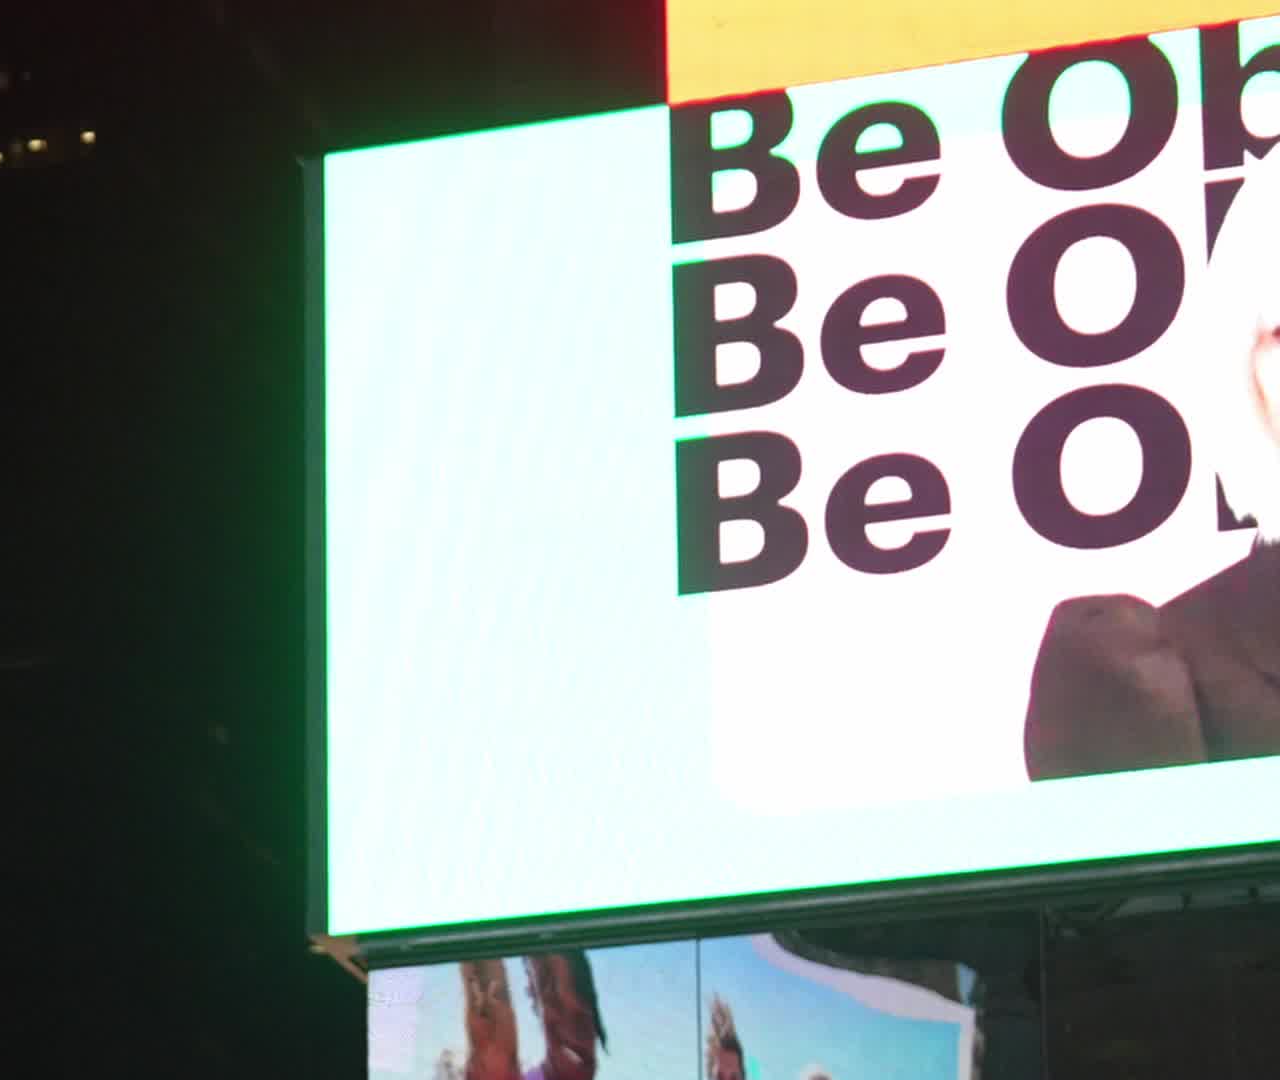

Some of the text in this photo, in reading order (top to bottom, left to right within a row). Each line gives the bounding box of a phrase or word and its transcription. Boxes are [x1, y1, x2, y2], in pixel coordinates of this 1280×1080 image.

[669, 88, 941, 246] Be
[672, 176, 1244, 417] Be O
[676, 383, 1257, 595] Be O
